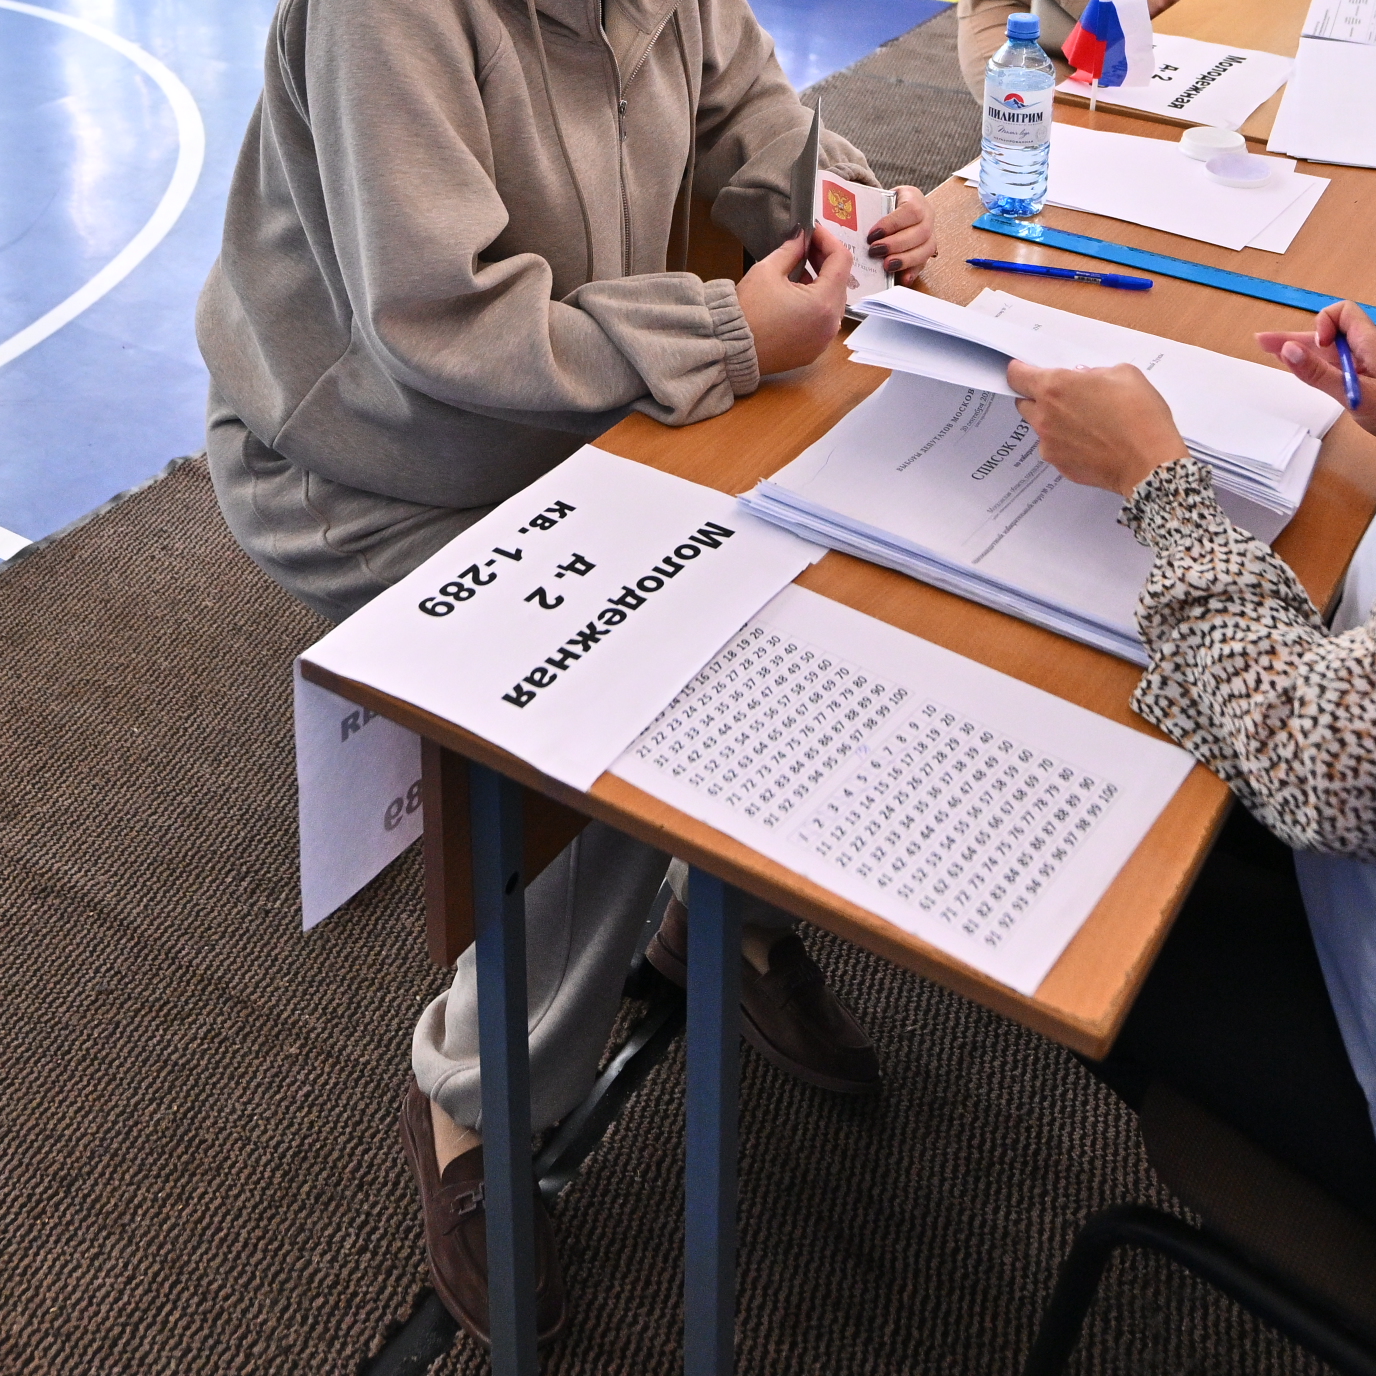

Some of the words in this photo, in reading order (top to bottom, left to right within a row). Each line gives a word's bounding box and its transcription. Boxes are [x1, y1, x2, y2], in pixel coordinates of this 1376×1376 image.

[988, 106, 1044, 123] ПИЛИГРИМ
[1151, 73, 1173, 82] 2
[1167, 54, 1247, 110] Молодежная
[896, 452, 922, 472] ВЫБОРЫ
[920, 423, 954, 454] ДЕПУТАТОВ
[971, 441, 1017, 481] СПИСОК
[517, 499, 577, 535] кв.
[553, 552, 596, 580] д.
[418, 546, 523, 617] 1-289
[501, 521, 736, 709] Молодежная
[524, 586, 565, 610] 2
[635, 743, 652, 759] 21
[650, 730, 667, 746] 22
[665, 717, 683, 732] 23
[681, 704, 698, 719] 24
[696, 691, 713, 707] 25
[710, 680, 727, 694] 26
[724, 668, 739, 683] 27
[738, 657, 754, 671] 28
[751, 645, 768, 659] 29
[765, 634, 781, 647] 30
[652, 753, 670, 768] 31
[669, 739, 685, 754] 32
[683, 726, 700, 741] 33
[701, 713, 716, 727] 34
[713, 700, 730, 715] 35
[727, 688, 745, 703] 36
[741, 676, 756, 691] 37
[755, 665, 771, 679] 38
[768, 653, 785, 667] 39
[783, 642, 798, 655] 40
[671, 762, 687, 776] 41
[686, 748, 703, 763] 42
[701, 735, 718, 749] 43
[717, 722, 733, 736] 44
[732, 709, 748, 723] 45
[746, 697, 762, 711] 46
[759, 684, 774, 698] 47
[773, 673, 789, 687] 48
[786, 662, 801, 675] 49
[799, 650, 815, 664] 50
[678, 682, 696, 698] 15
[693, 670, 711, 686] 16
[708, 660, 723, 674] 17
[721, 648, 738, 663] 18
[735, 637, 751, 651] 19
[748, 626, 765, 640] 20
[688, 772, 705, 787] 51
[703, 758, 720, 773] 52
[718, 744, 736, 760] 53
[733, 731, 751, 746] 54
[748, 718, 765, 733] 55
[762, 706, 779, 720] 56
[776, 693, 791, 708] 57
[789, 682, 806, 696] 58
[802, 670, 819, 684] 59
[816, 658, 833, 671] 60
[706, 781, 724, 796] 61
[721, 767, 739, 783] 62
[736, 754, 754, 769] 63
[751, 740, 769, 755] 64
[766, 727, 783, 742] 65
[780, 714, 797, 728] 66
[794, 701, 809, 716] 67
[807, 690, 824, 704] 68
[820, 678, 837, 692] 69
[833, 666, 850, 680] 70
[724, 791, 743, 807] 71
[739, 777, 757, 793] 72
[755, 763, 772, 779] 73
[770, 749, 787, 765] 74
[784, 736, 802, 751] 75
[798, 723, 816, 738] 76
[811, 710, 827, 725] 77
[825, 699, 842, 713] 78
[838, 687, 855, 701] 79
[851, 675, 868, 688] 80
[743, 801, 761, 816] 81
[758, 787, 775, 803] 82
[773, 773, 791, 788] 83
[788, 759, 806, 774] 84
[803, 746, 820, 760] 85
[816, 733, 834, 747] 86
[830, 719, 845, 734] 87
[843, 708, 860, 721] 88
[856, 695, 873, 709] 89
[869, 683, 886, 697] 90
[762, 811, 780, 828] 91
[777, 797, 795, 813] 92
[792, 782, 810, 799] 93
[806, 768, 824, 784] 94
[821, 755, 839, 770] 95
[835, 742, 852, 757] 96
[848, 728, 864, 743] 97
[861, 716, 878, 730] 98
[874, 704, 891, 718] 99
[888, 687, 908, 705] 100
[812, 817, 824, 829] 2
[826, 802, 839, 814] 3
[842, 787, 854, 798] 4
[855, 772, 868, 784] 5
[869, 759, 882, 769] 6
[882, 744, 893, 756] 7
[895, 734, 908, 743] 8
[907, 720, 920, 731] 9
[921, 703, 937, 718] 10
[814, 840, 833, 857] 11
[829, 824, 847, 841] 12
[844, 809, 862, 826] 13
[858, 794, 876, 810] 14
[872, 779, 890, 795] 15
[886, 766, 903, 781] 16
[899, 751, 915, 767] 17
[912, 740, 929, 755] 18
[924, 727, 941, 742] 19
[939, 713, 956, 727] 20
[834, 851, 853, 868] 21
[849, 835, 866, 853] 22
[863, 819, 882, 836] 23
[878, 803, 896, 821] 24
[892, 789, 910, 806] 25
[905, 775, 923, 791] 26
[918, 761, 934, 777] 27
[931, 750, 948, 764] 28
[943, 737, 960, 752] 29
[958, 721, 975, 736] 30
